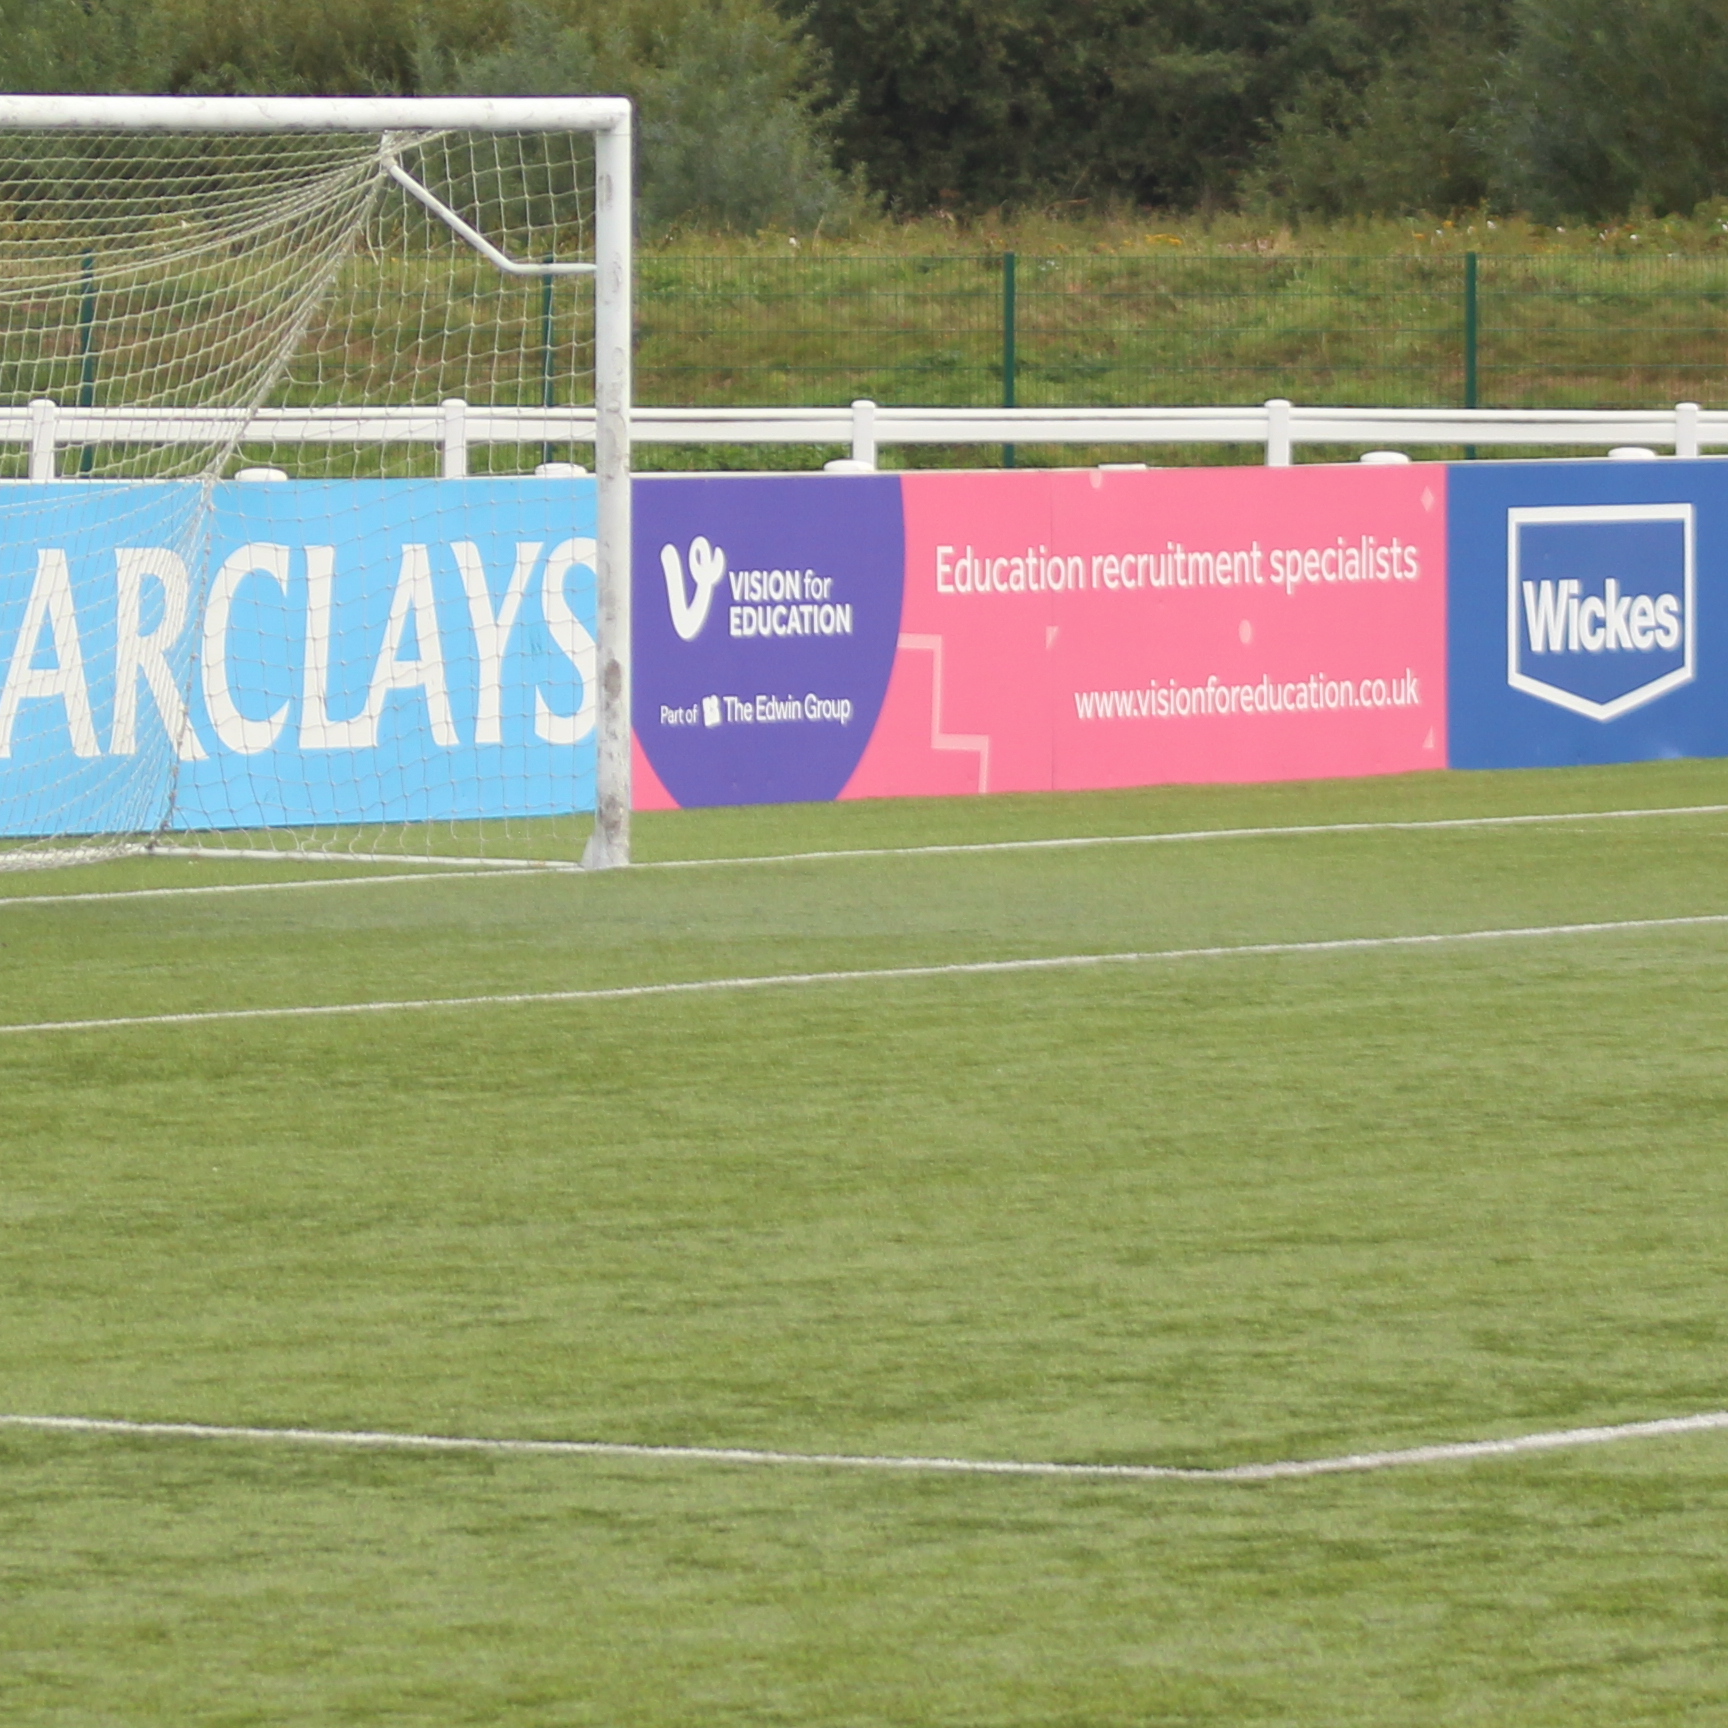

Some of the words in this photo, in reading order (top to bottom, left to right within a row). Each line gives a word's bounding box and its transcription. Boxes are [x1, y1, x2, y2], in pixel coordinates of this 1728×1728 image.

[728, 569, 800, 601] VISION
[803, 568, 832, 599] for
[936, 545, 1084, 593] Education
[1091, 541, 1264, 588] recruitment
[1269, 535, 1419, 595] specialists
[729, 603, 851, 636] EDUCATION
[1523, 577, 1682, 653] Wickes
[660, 705, 683, 724] Part
[685, 704, 698, 723] of
[723, 696, 753, 722] The
[756, 694, 801, 720] Edwin
[804, 692, 851, 726] Group
[1074, 668, 1420, 720] www.visionforeducation.co.uk
